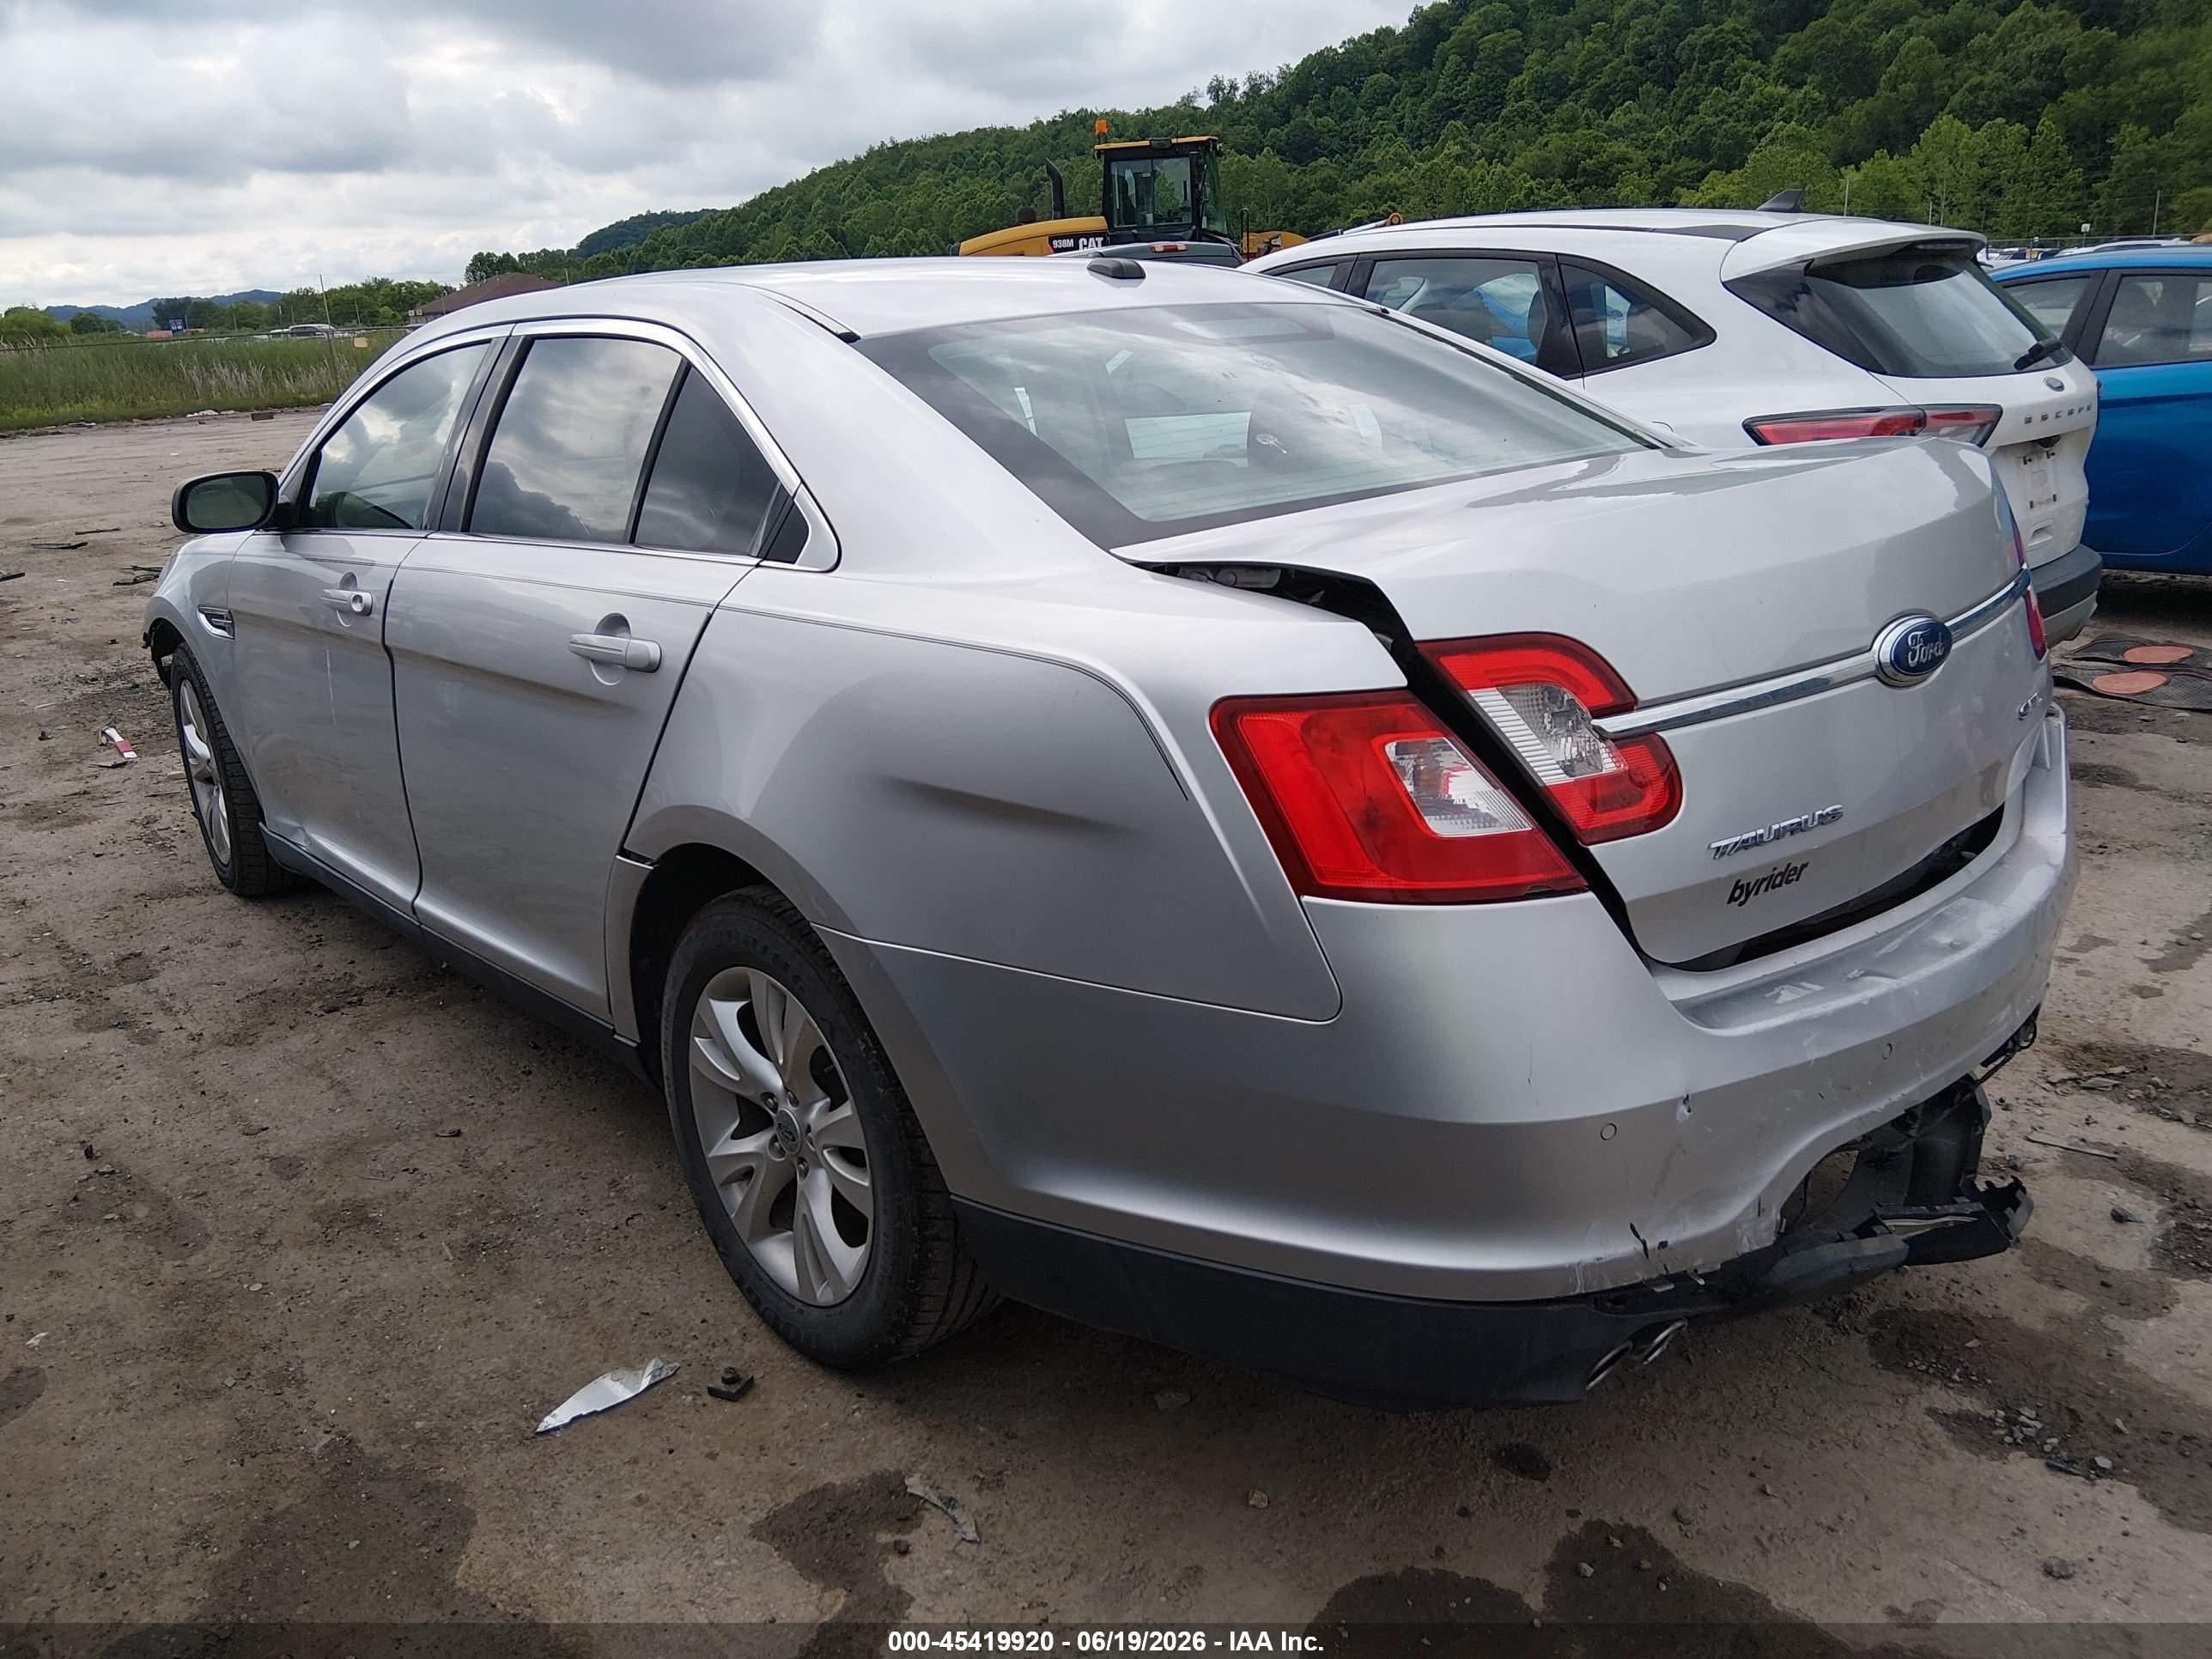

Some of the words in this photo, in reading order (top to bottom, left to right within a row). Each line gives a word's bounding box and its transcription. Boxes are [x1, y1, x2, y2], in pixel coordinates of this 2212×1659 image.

[1053, 238, 1074, 249] 938M
[1079, 237, 1104, 252] CAT
[1906, 629, 1946, 668] Ford
[1707, 804, 1844, 860] TAURUS
[1726, 860, 1810, 908] byrider
